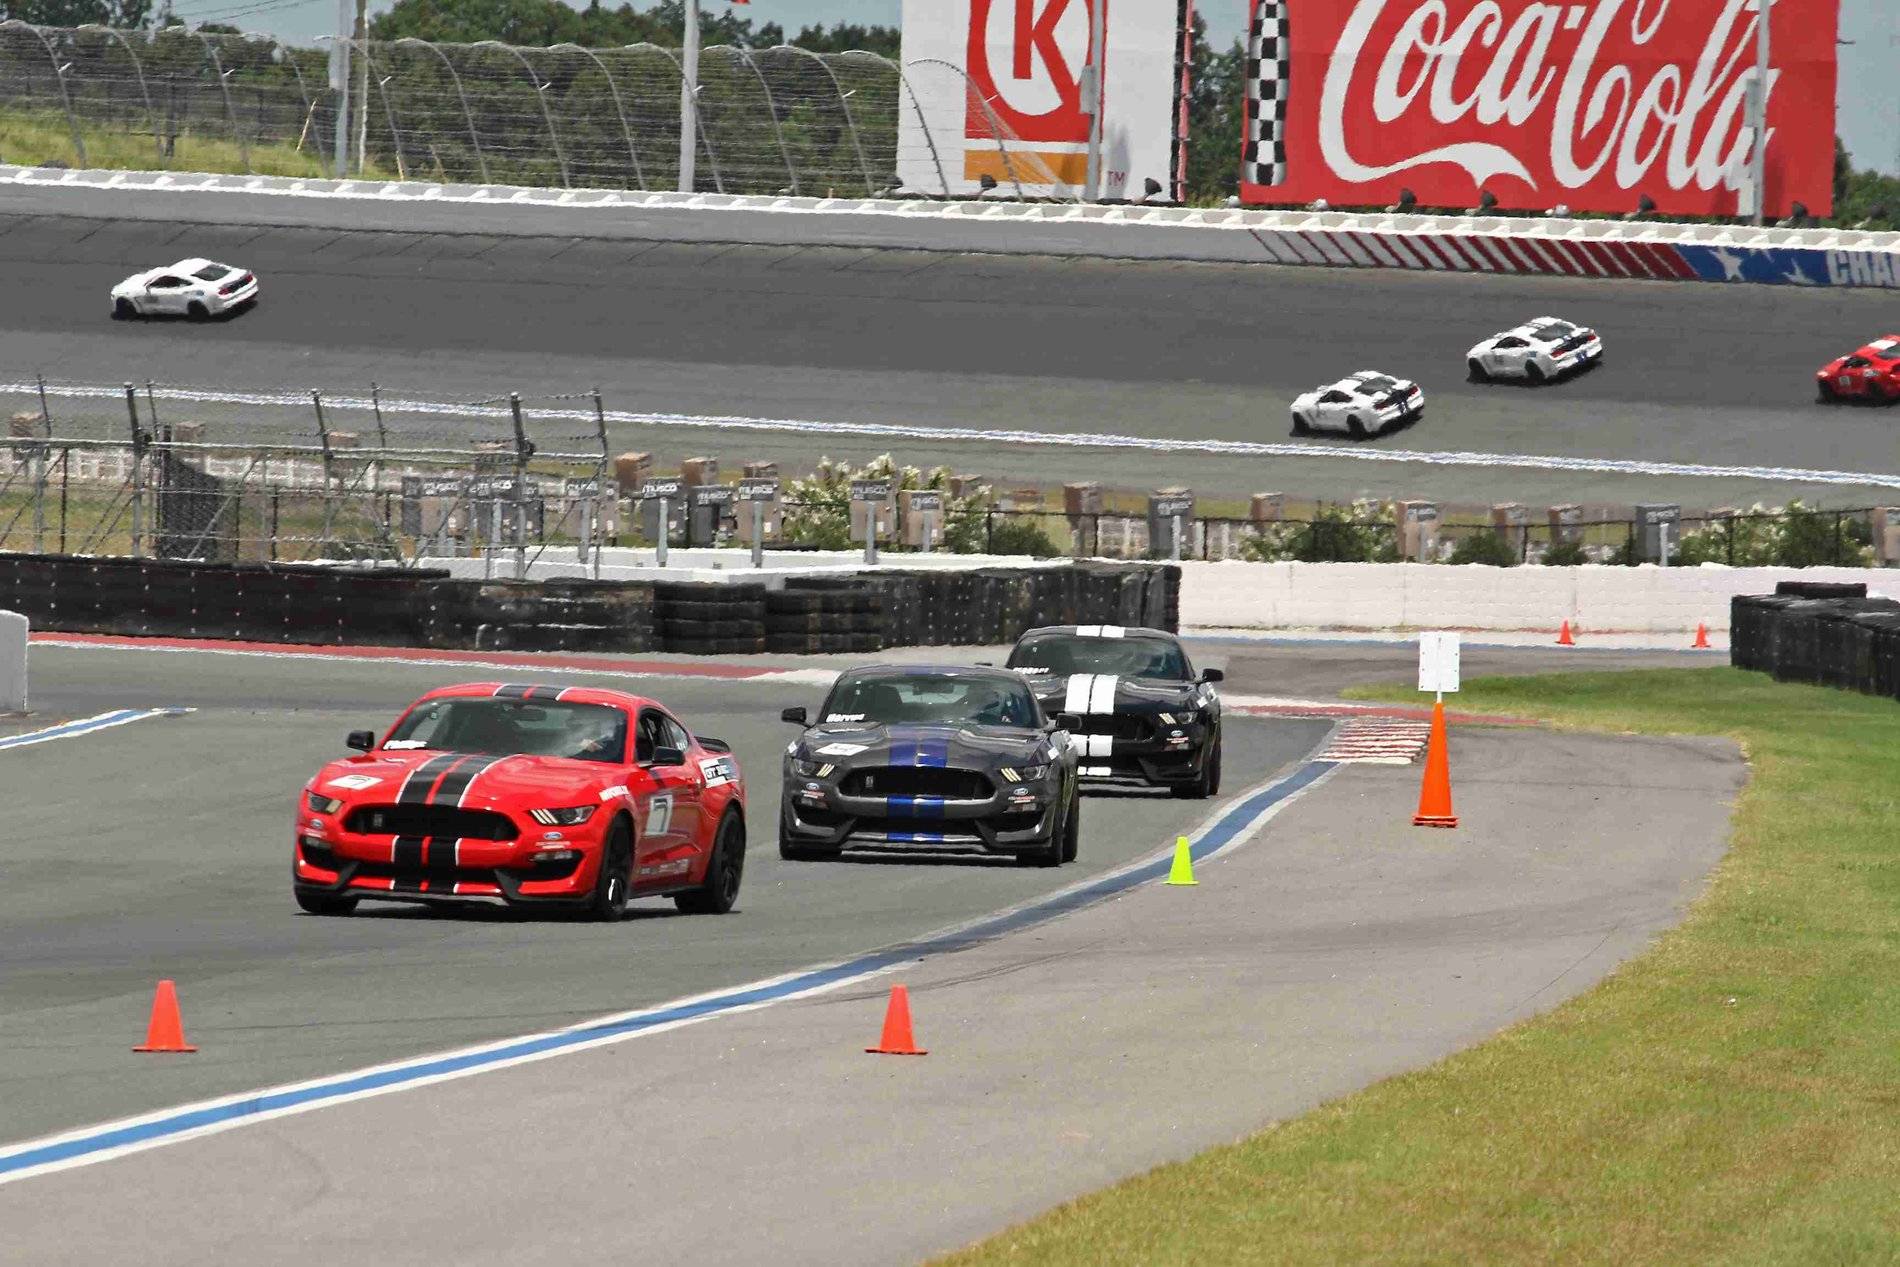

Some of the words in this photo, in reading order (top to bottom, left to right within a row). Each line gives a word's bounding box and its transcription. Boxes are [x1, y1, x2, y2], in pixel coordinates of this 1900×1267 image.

[1318, 0, 1782, 192] Coca-Cola
[1107, 170, 1127, 187] TM
[1826, 249, 1900, 288] CHA
[653, 797, 668, 834] 7
